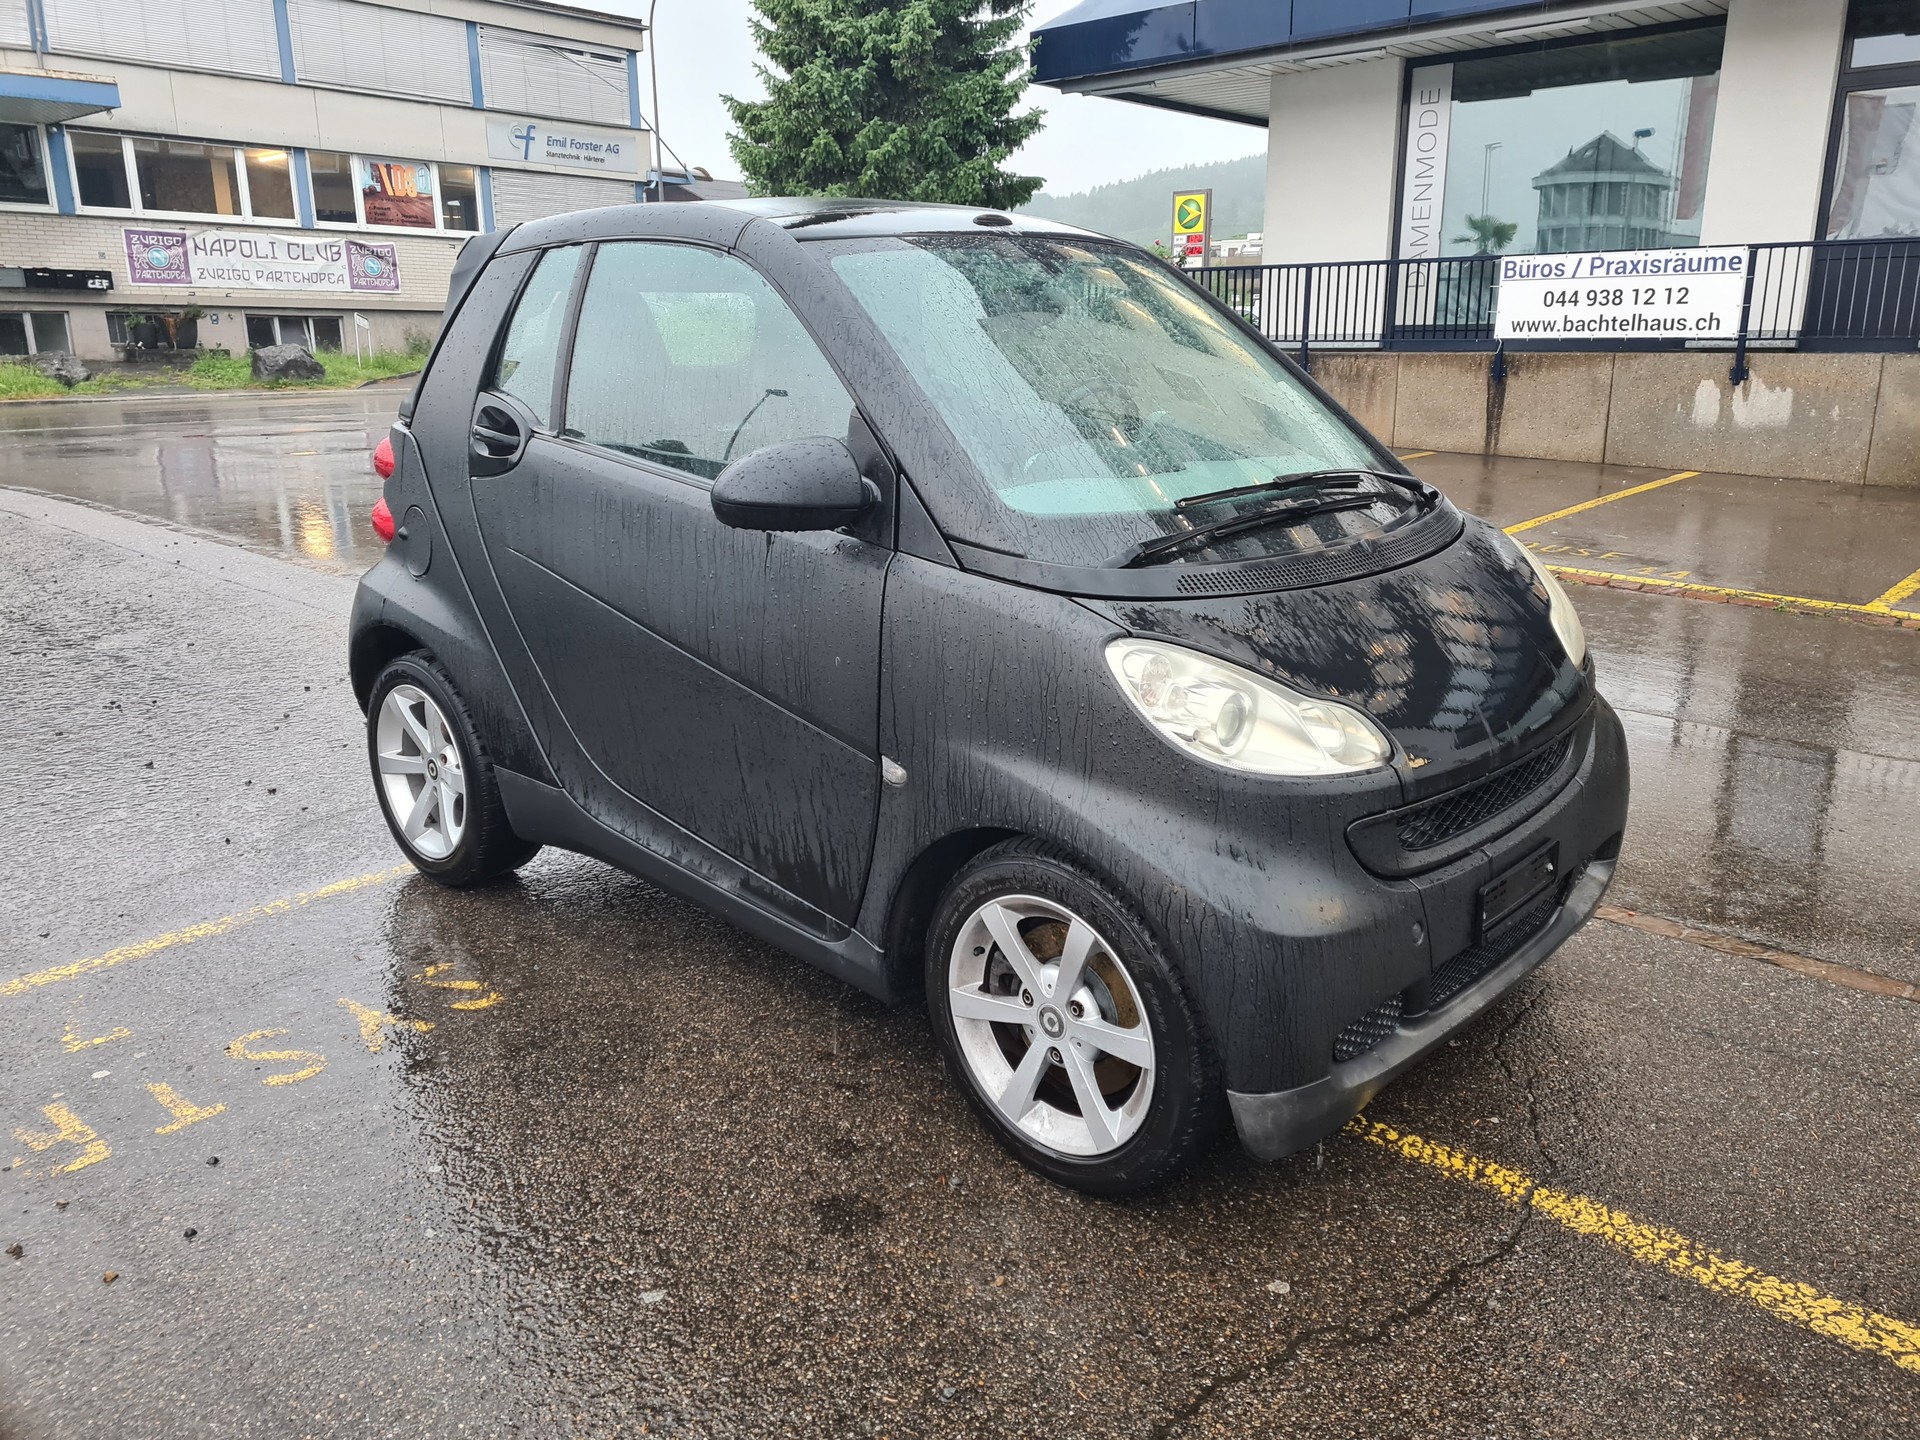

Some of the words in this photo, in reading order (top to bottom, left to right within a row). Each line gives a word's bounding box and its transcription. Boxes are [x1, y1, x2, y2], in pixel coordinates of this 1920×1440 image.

[546, 136, 567, 148] Emil
[569, 139, 603, 152] Forster
[605, 143, 620, 154] AG
[545, 150, 580, 161] Stanztechnik
[1407, 87, 1441, 288] DAMENMODE
[192, 237, 279, 261] NAPOLI
[1503, 260, 1566, 279] Büros
[1589, 253, 1743, 276] Praxisräume
[255, 271, 345, 285] PARTENOPEA
[1543, 290, 1580, 307] 044
[1586, 289, 1624, 306] 938
[1632, 288, 1656, 306] 12
[1664, 287, 1689, 305] 12
[1511, 312, 1721, 333] www.bachtelhaus.ch
